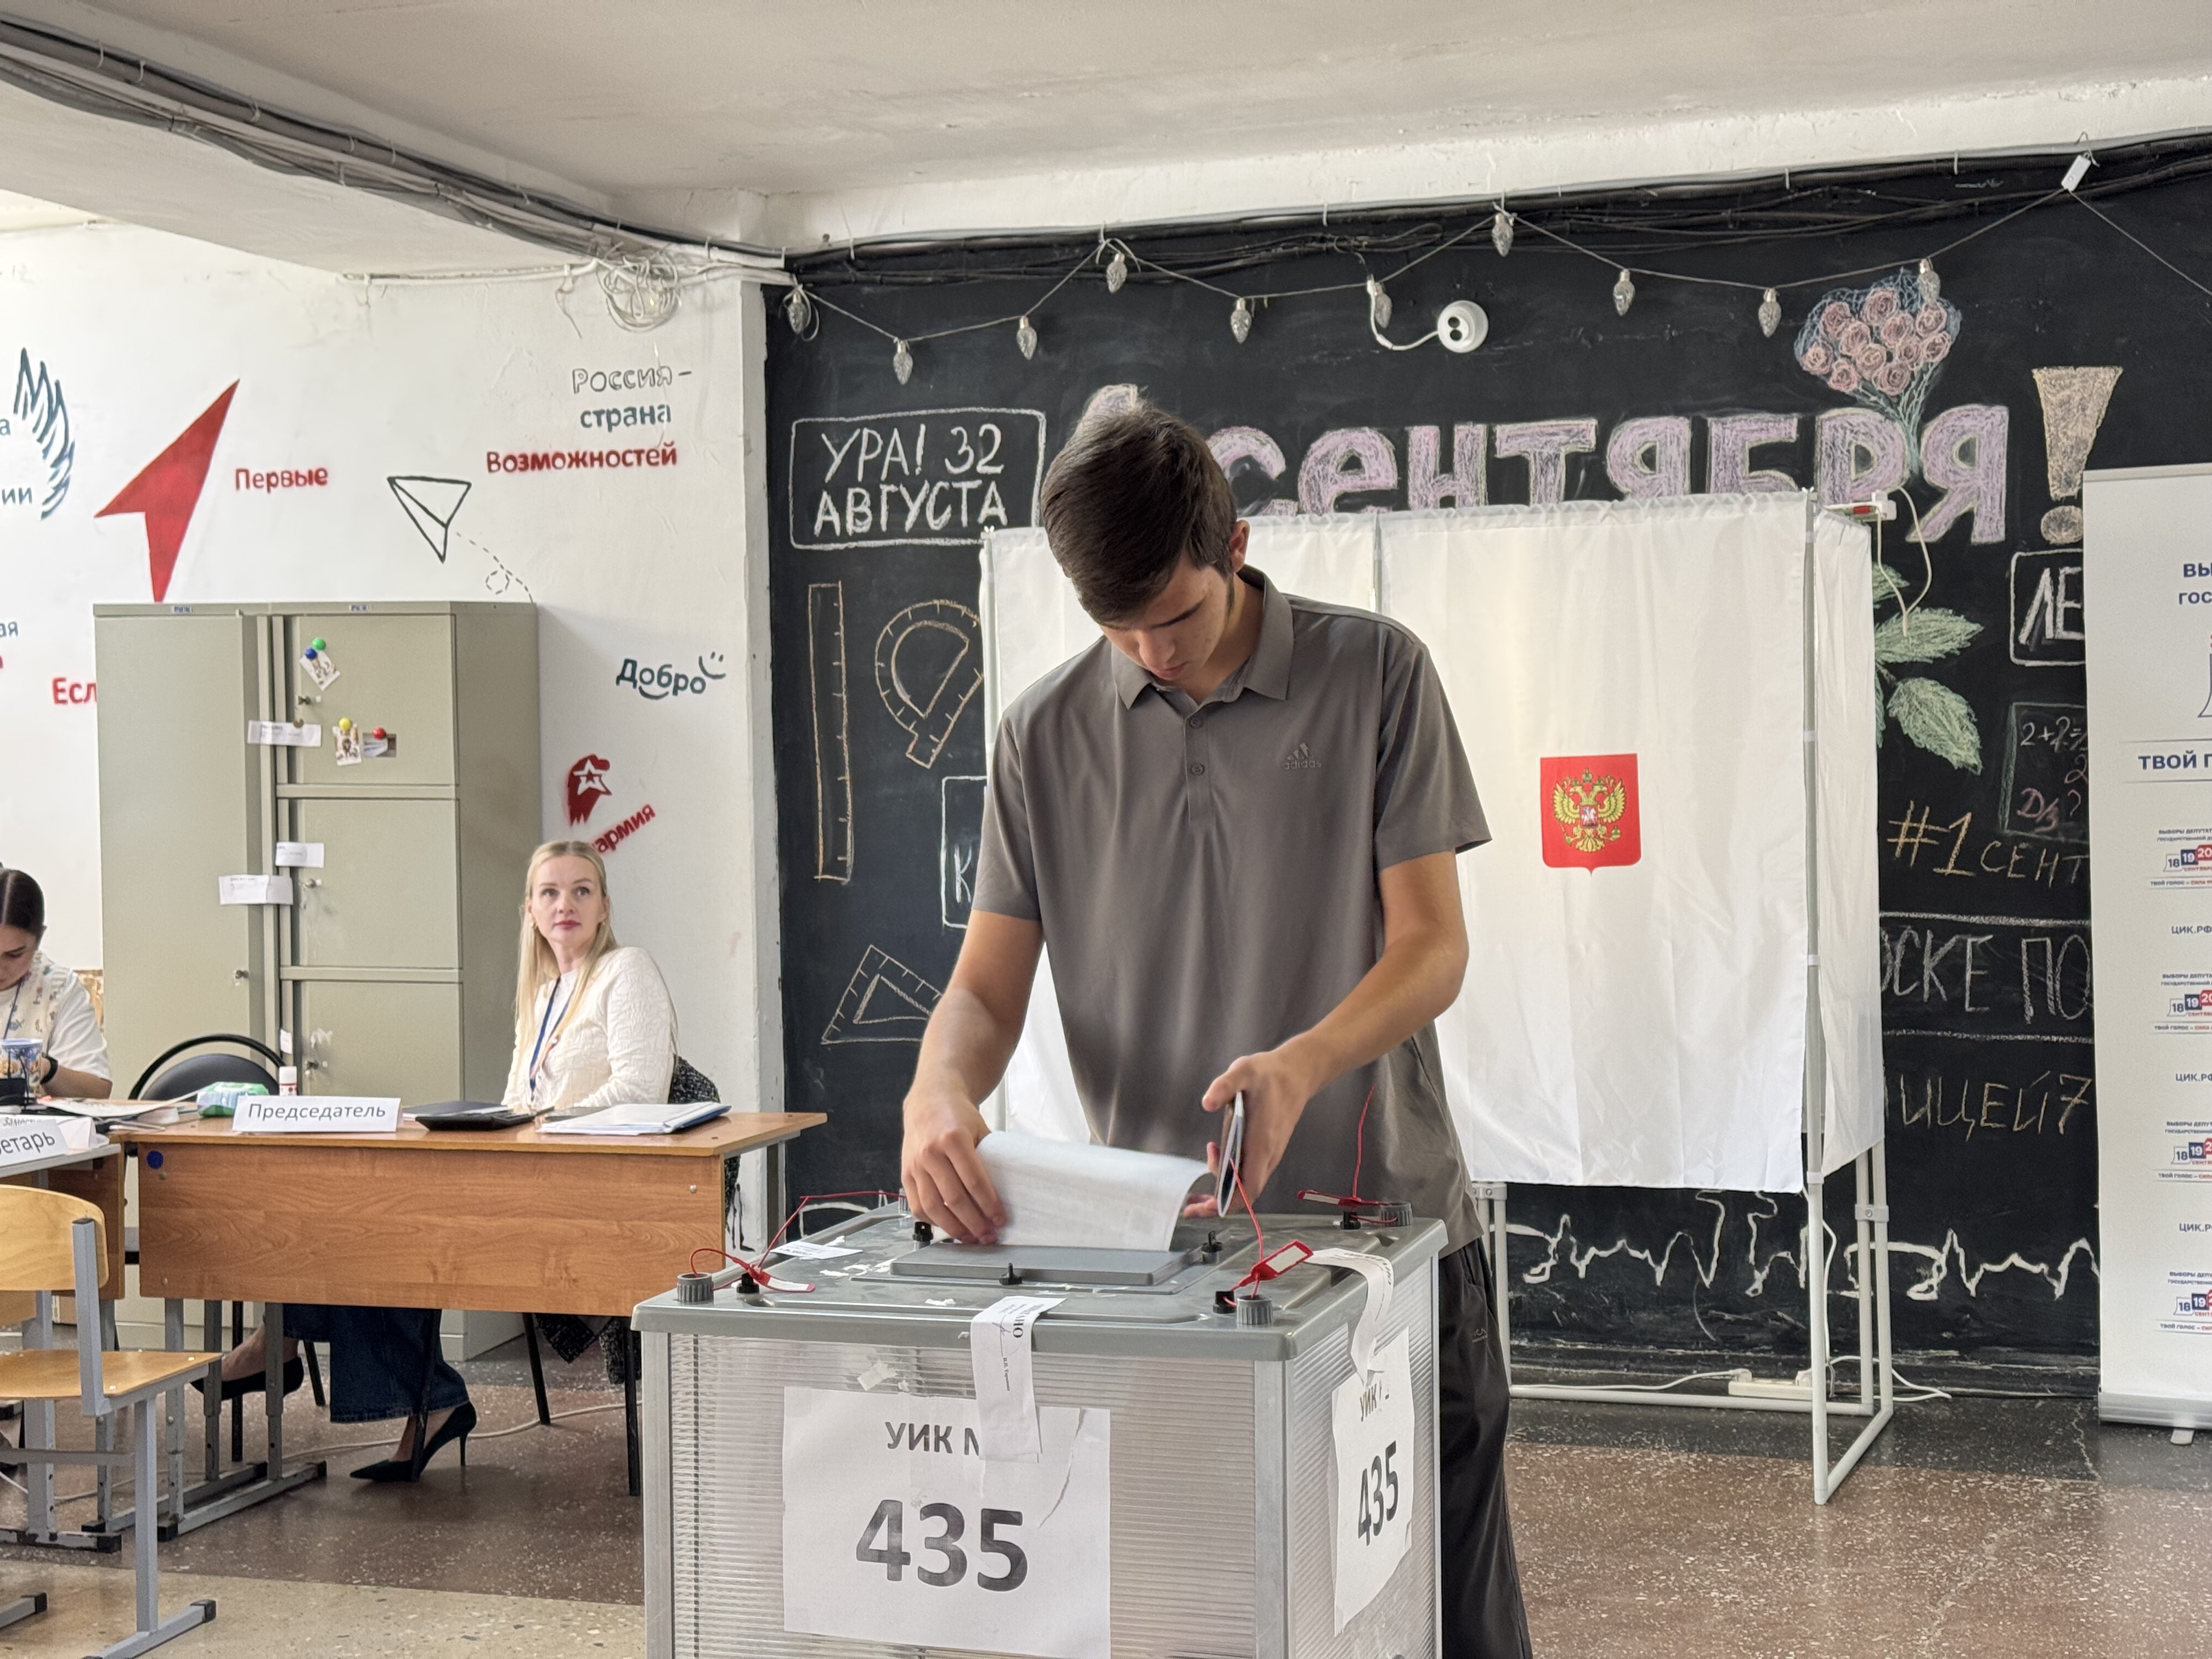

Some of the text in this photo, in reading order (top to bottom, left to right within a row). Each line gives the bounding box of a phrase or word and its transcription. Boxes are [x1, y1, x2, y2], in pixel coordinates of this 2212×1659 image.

[580, 404, 672, 432] страна
[487, 441, 677, 473] Возможностей
[821, 424, 1005, 483] УРА! 32
[234, 467, 328, 493] Первые
[814, 480, 1008, 537] АВГУСТА
[616, 658, 706, 697] Добро
[1283, 759, 1322, 770] adidas
[2137, 749, 2197, 770] ТВОЙ
[591, 804, 656, 854] армия
[2168, 847, 2212, 868] 18 19 20
[2171, 926, 2212, 935] ЦИК.РФ
[2172, 1003, 2184, 1013] 18
[2186, 997, 2199, 1008] 19
[248, 1103, 386, 1121] Председатель
[0, 1131, 55, 1154] етарь
[2176, 1151, 2188, 1161] 18
[2190, 1146, 2203, 1156] 19
[2179, 1223, 2212, 1233] ЦИК.Р
[2179, 1302, 2191, 1312] 18
[2193, 1296, 2207, 1308] 19
[884, 1421, 953, 1454] УИК
[1358, 1440, 1399, 1547] 435
[856, 1499, 1029, 1592] 435
